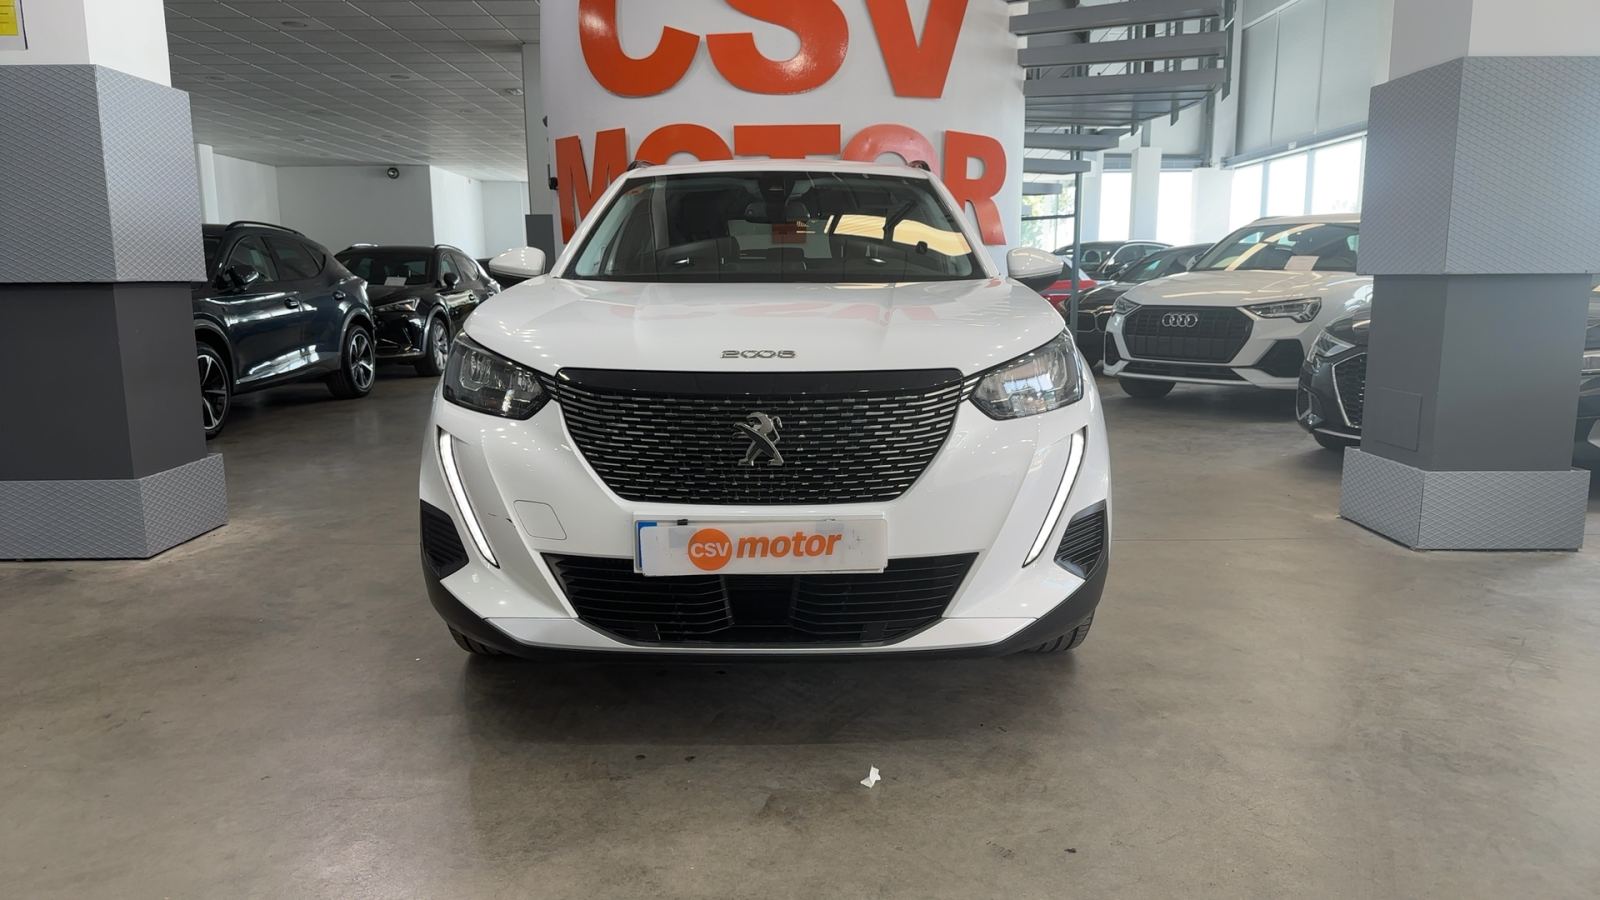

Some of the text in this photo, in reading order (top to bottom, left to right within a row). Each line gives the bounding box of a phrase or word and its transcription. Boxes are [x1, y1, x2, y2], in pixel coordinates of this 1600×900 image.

[720, 349, 796, 359] 2008
[690, 531, 842, 559] CSV motor
